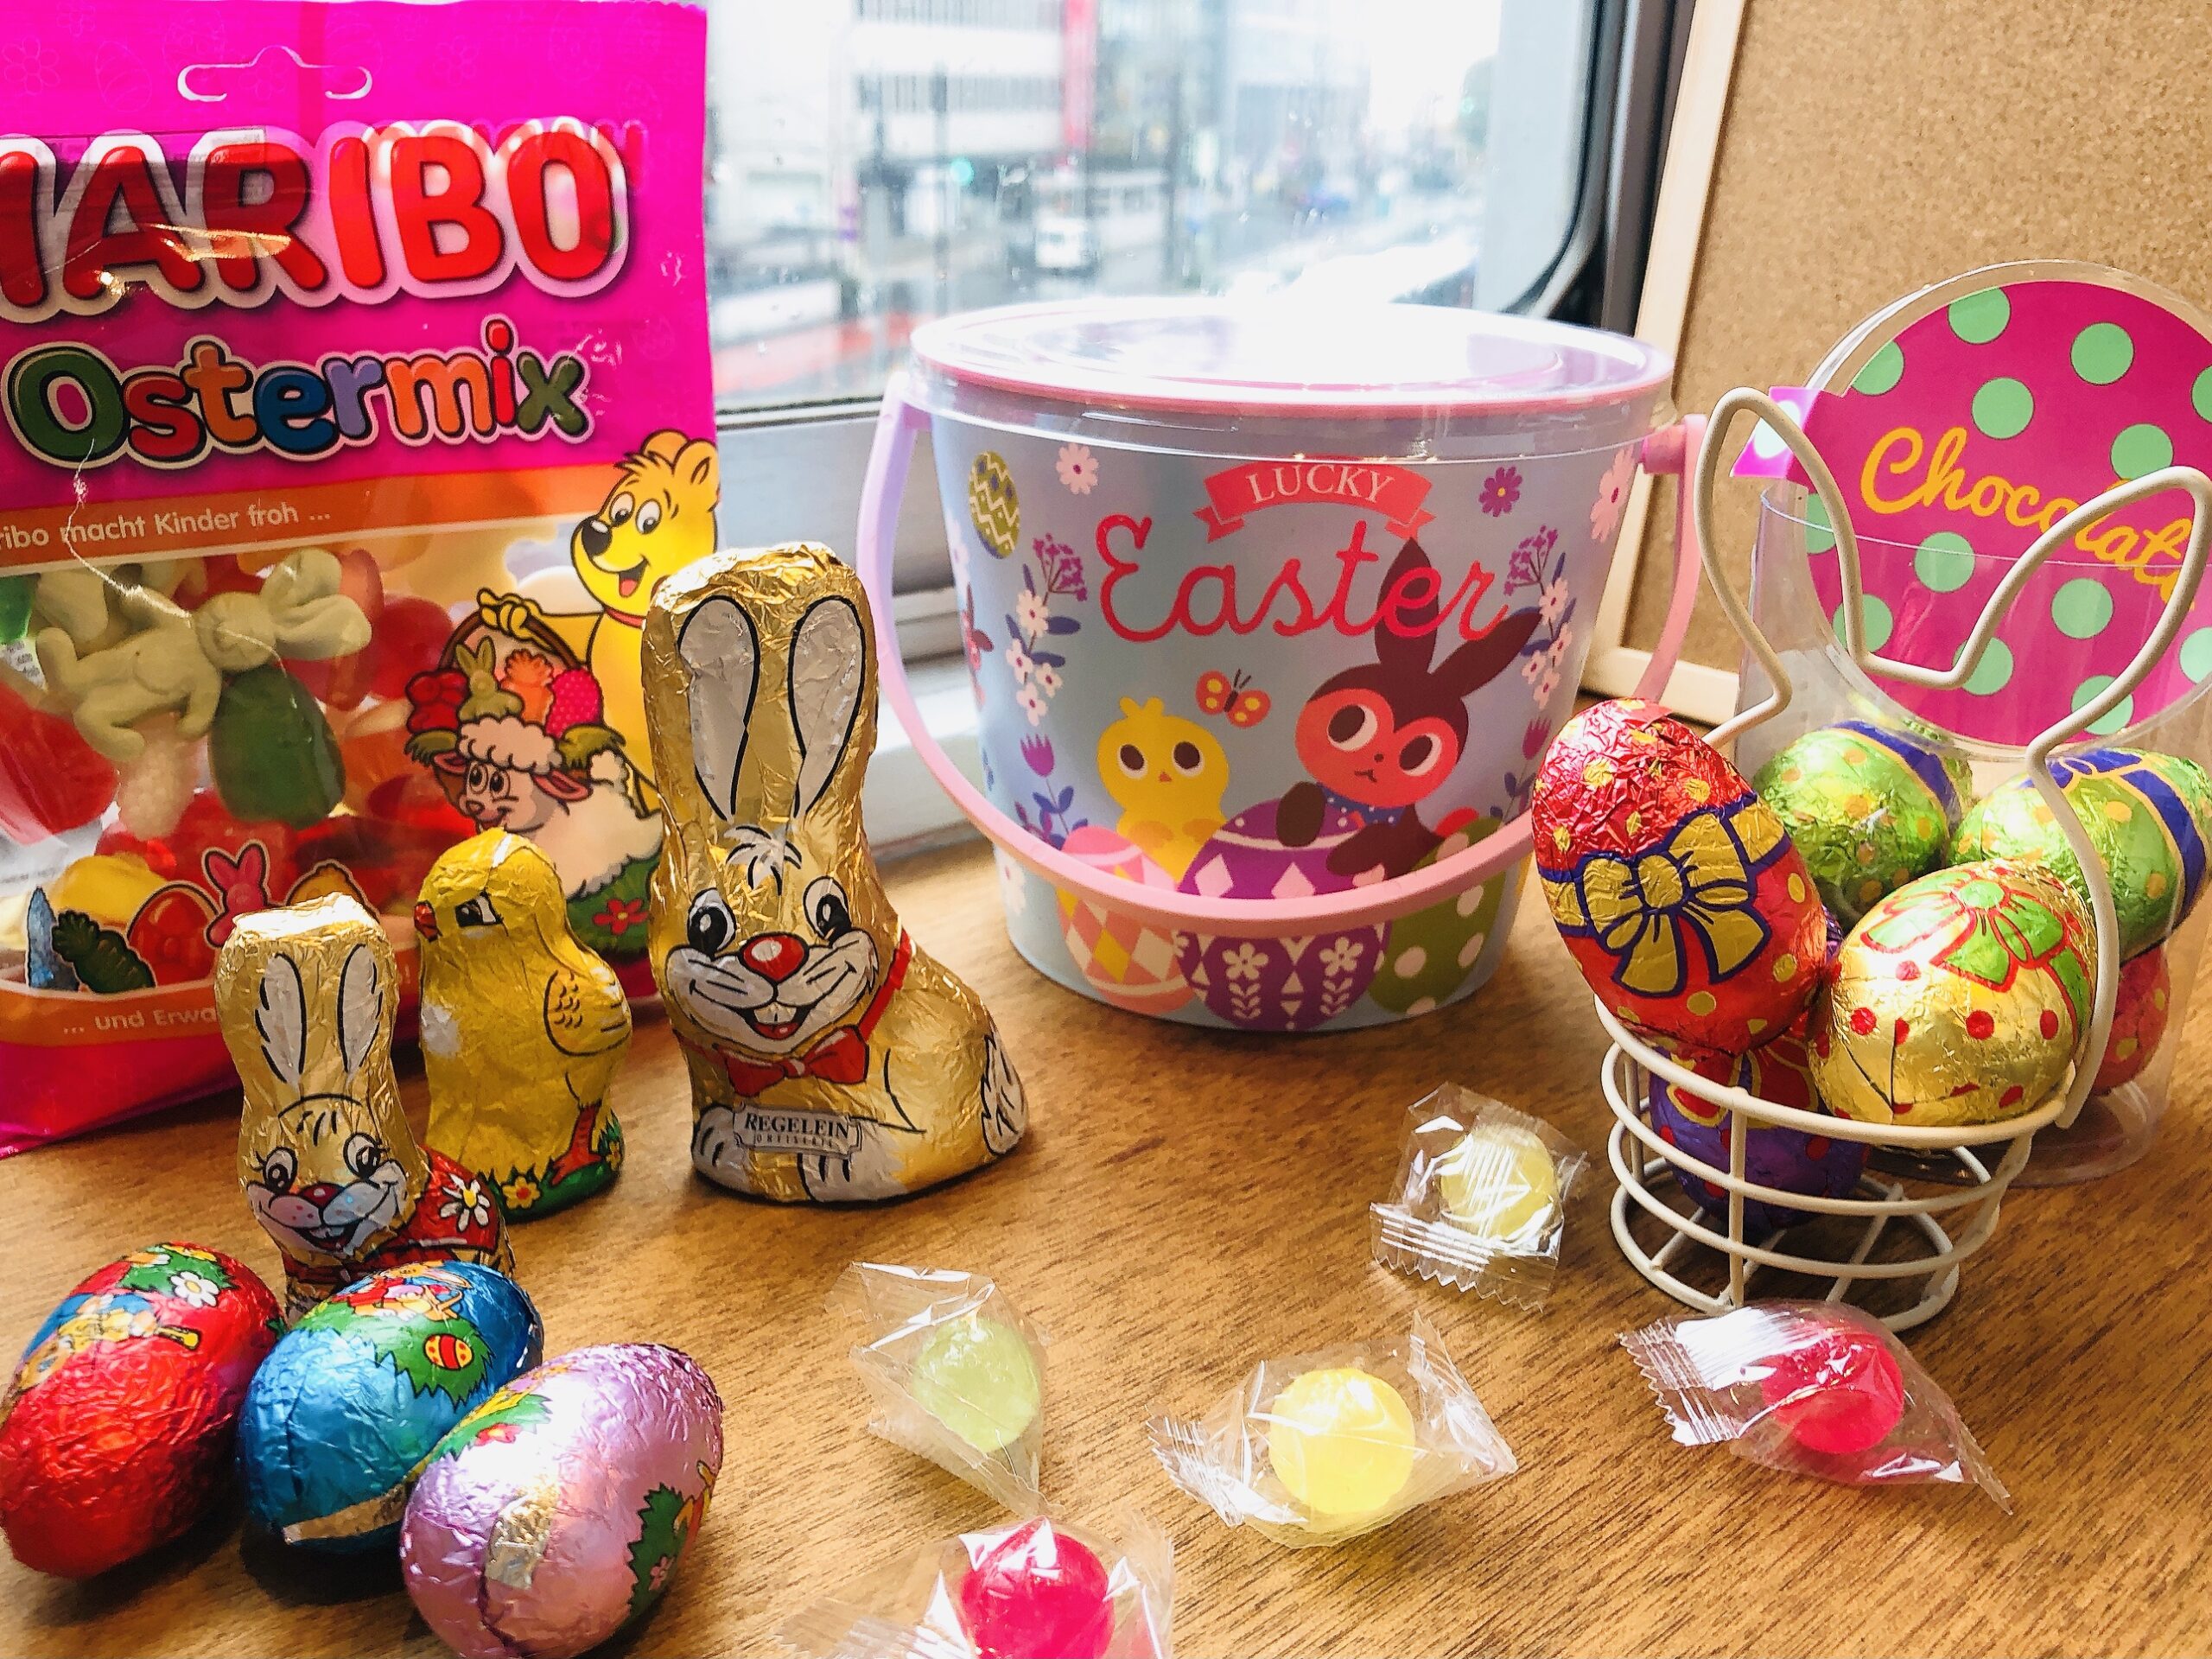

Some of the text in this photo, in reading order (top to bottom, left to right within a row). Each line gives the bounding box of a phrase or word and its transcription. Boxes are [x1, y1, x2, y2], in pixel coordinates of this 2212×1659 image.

[9, 319, 591, 463] Ostermix
[1244, 463, 1395, 505] LUCKY
[60, 514, 146, 544] macht
[154, 507, 240, 536] Kinder
[247, 501, 300, 528] froh
[1859, 425, 2196, 611] Chocolat
[1095, 513, 1509, 643] Easter
[93, 1009, 145, 1031] und
[152, 1007, 217, 1027] Erwa
[744, 1112, 849, 1140] REGELEIN
